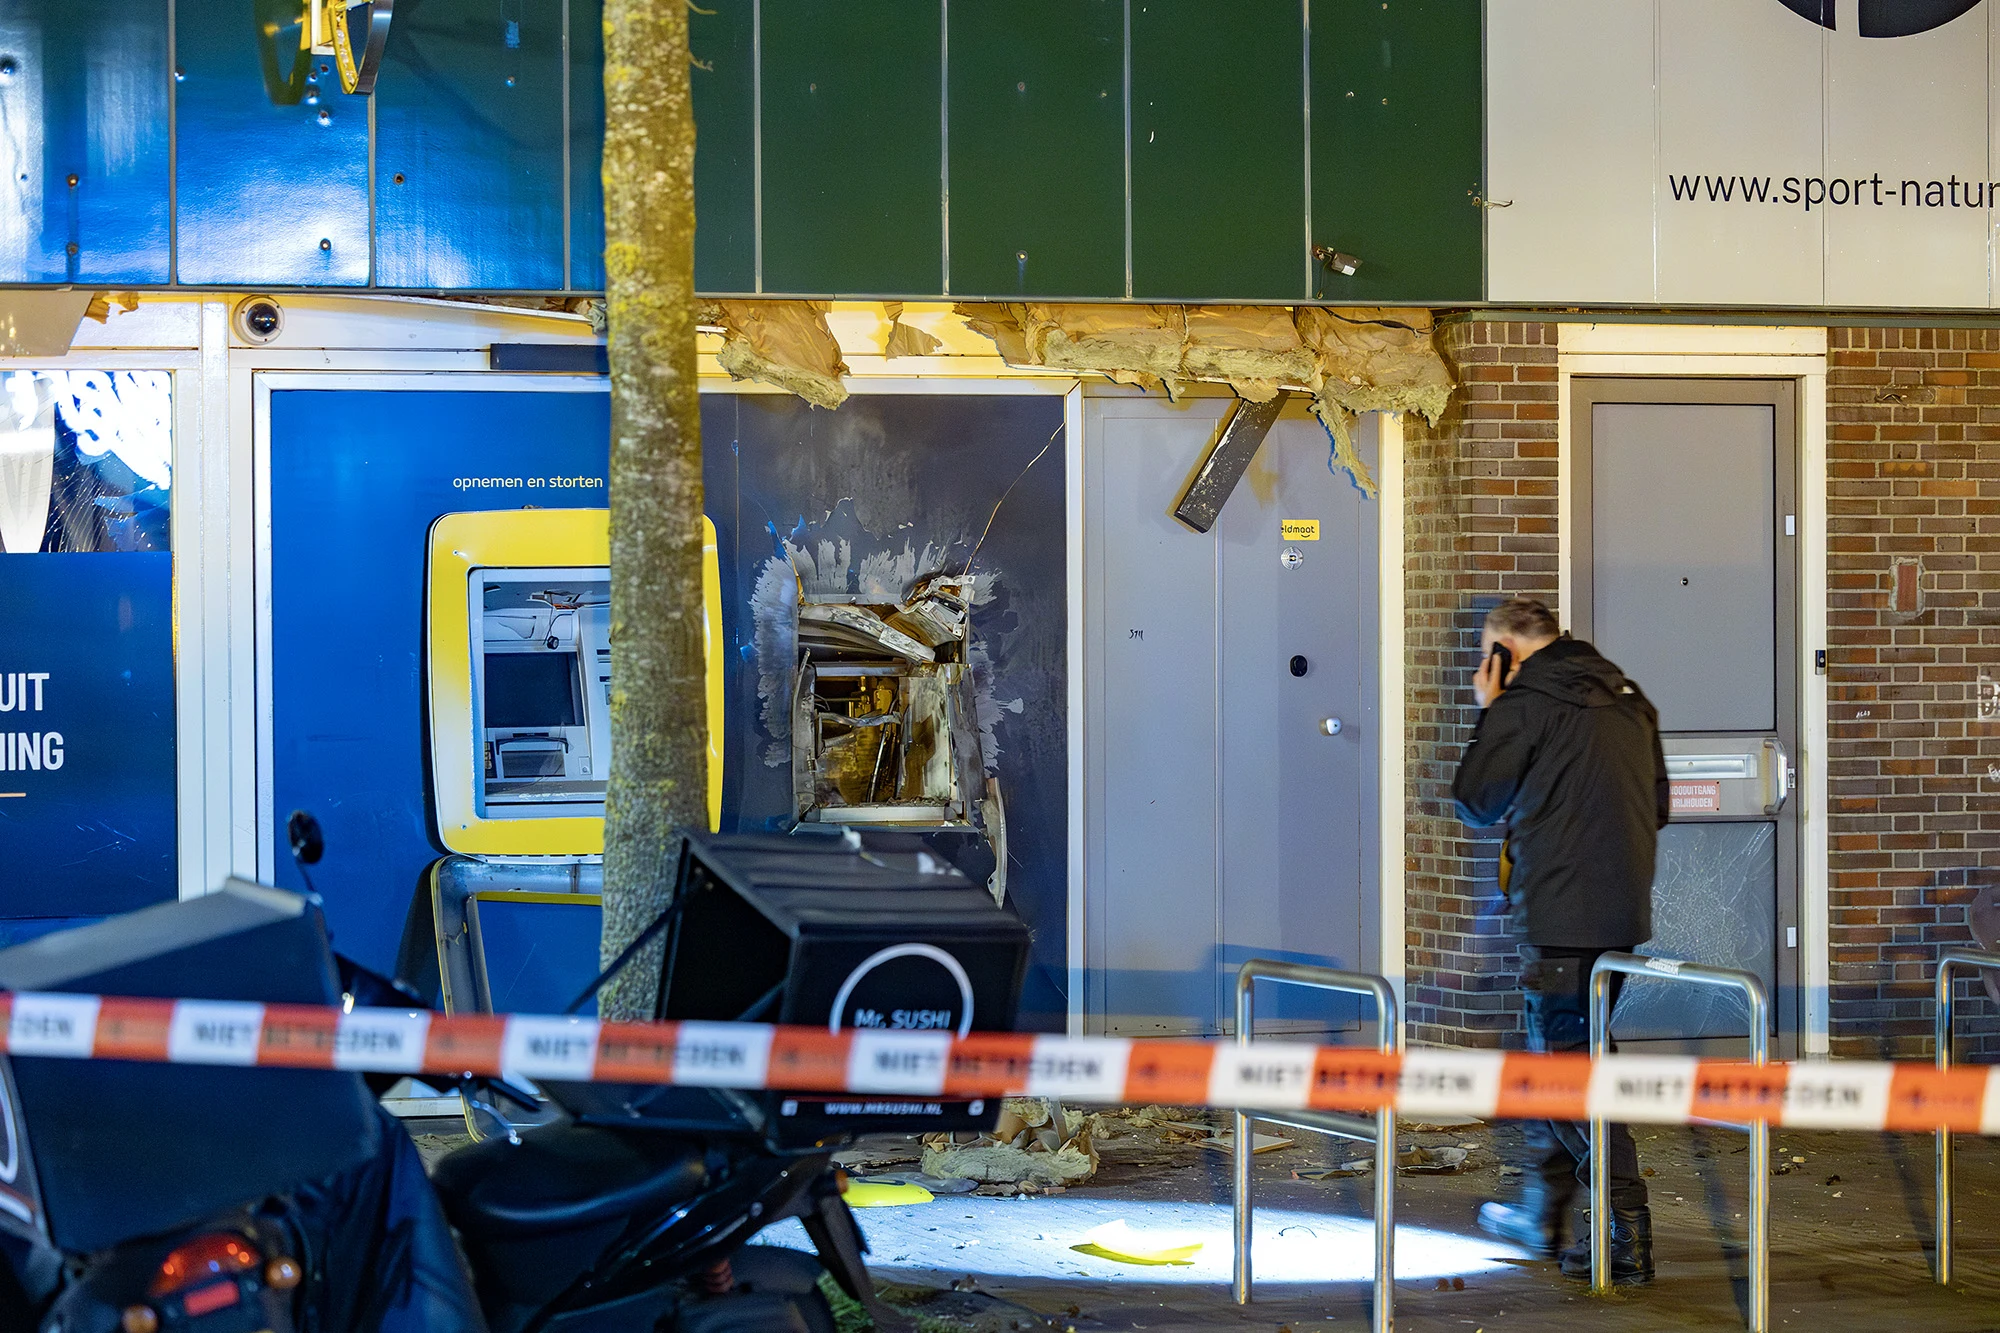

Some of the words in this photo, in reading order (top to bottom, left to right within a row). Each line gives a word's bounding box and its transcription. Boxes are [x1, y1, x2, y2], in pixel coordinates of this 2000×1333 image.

[1669, 172, 2000, 211] www.sport-natur
[452, 477, 523, 492] opnemen
[527, 477, 546, 489] en
[549, 475, 604, 489] storten
[0, 731, 64, 771] ING
[1671, 797, 1714, 808] VRIJHOUDEN
[890, 1009, 951, 1029] SUSHI
[1236, 1062, 1310, 1088] NIET
[1616, 1075, 1685, 1102] NIET
[1700, 1079, 1863, 1108] BETREDEN
